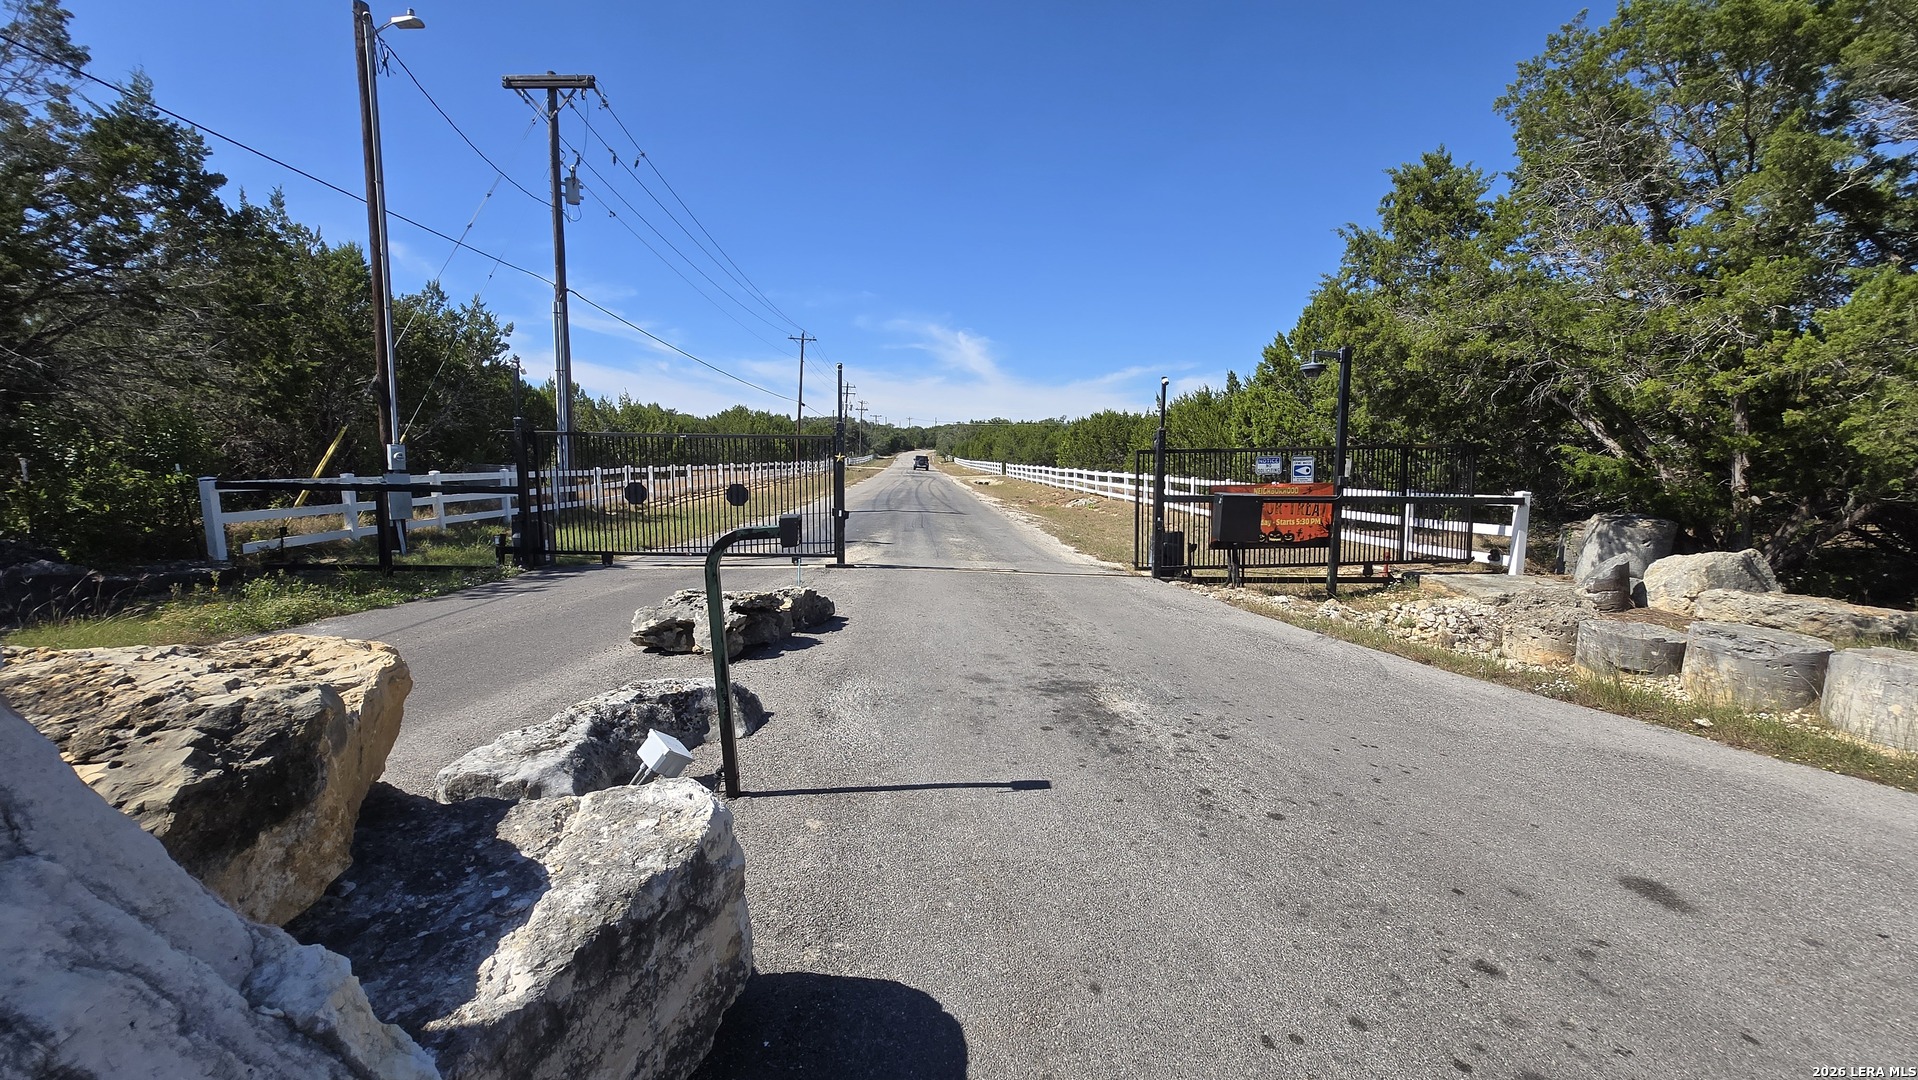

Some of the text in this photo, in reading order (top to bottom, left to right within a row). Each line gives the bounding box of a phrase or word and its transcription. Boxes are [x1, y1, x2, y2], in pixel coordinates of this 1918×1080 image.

[1253, 487, 1299, 495] NEIGHBORHOOD
[1275, 518, 1295, 526] Starts
[1296, 518, 1309, 526] 5:30
[1310, 517, 1321, 525] PM
